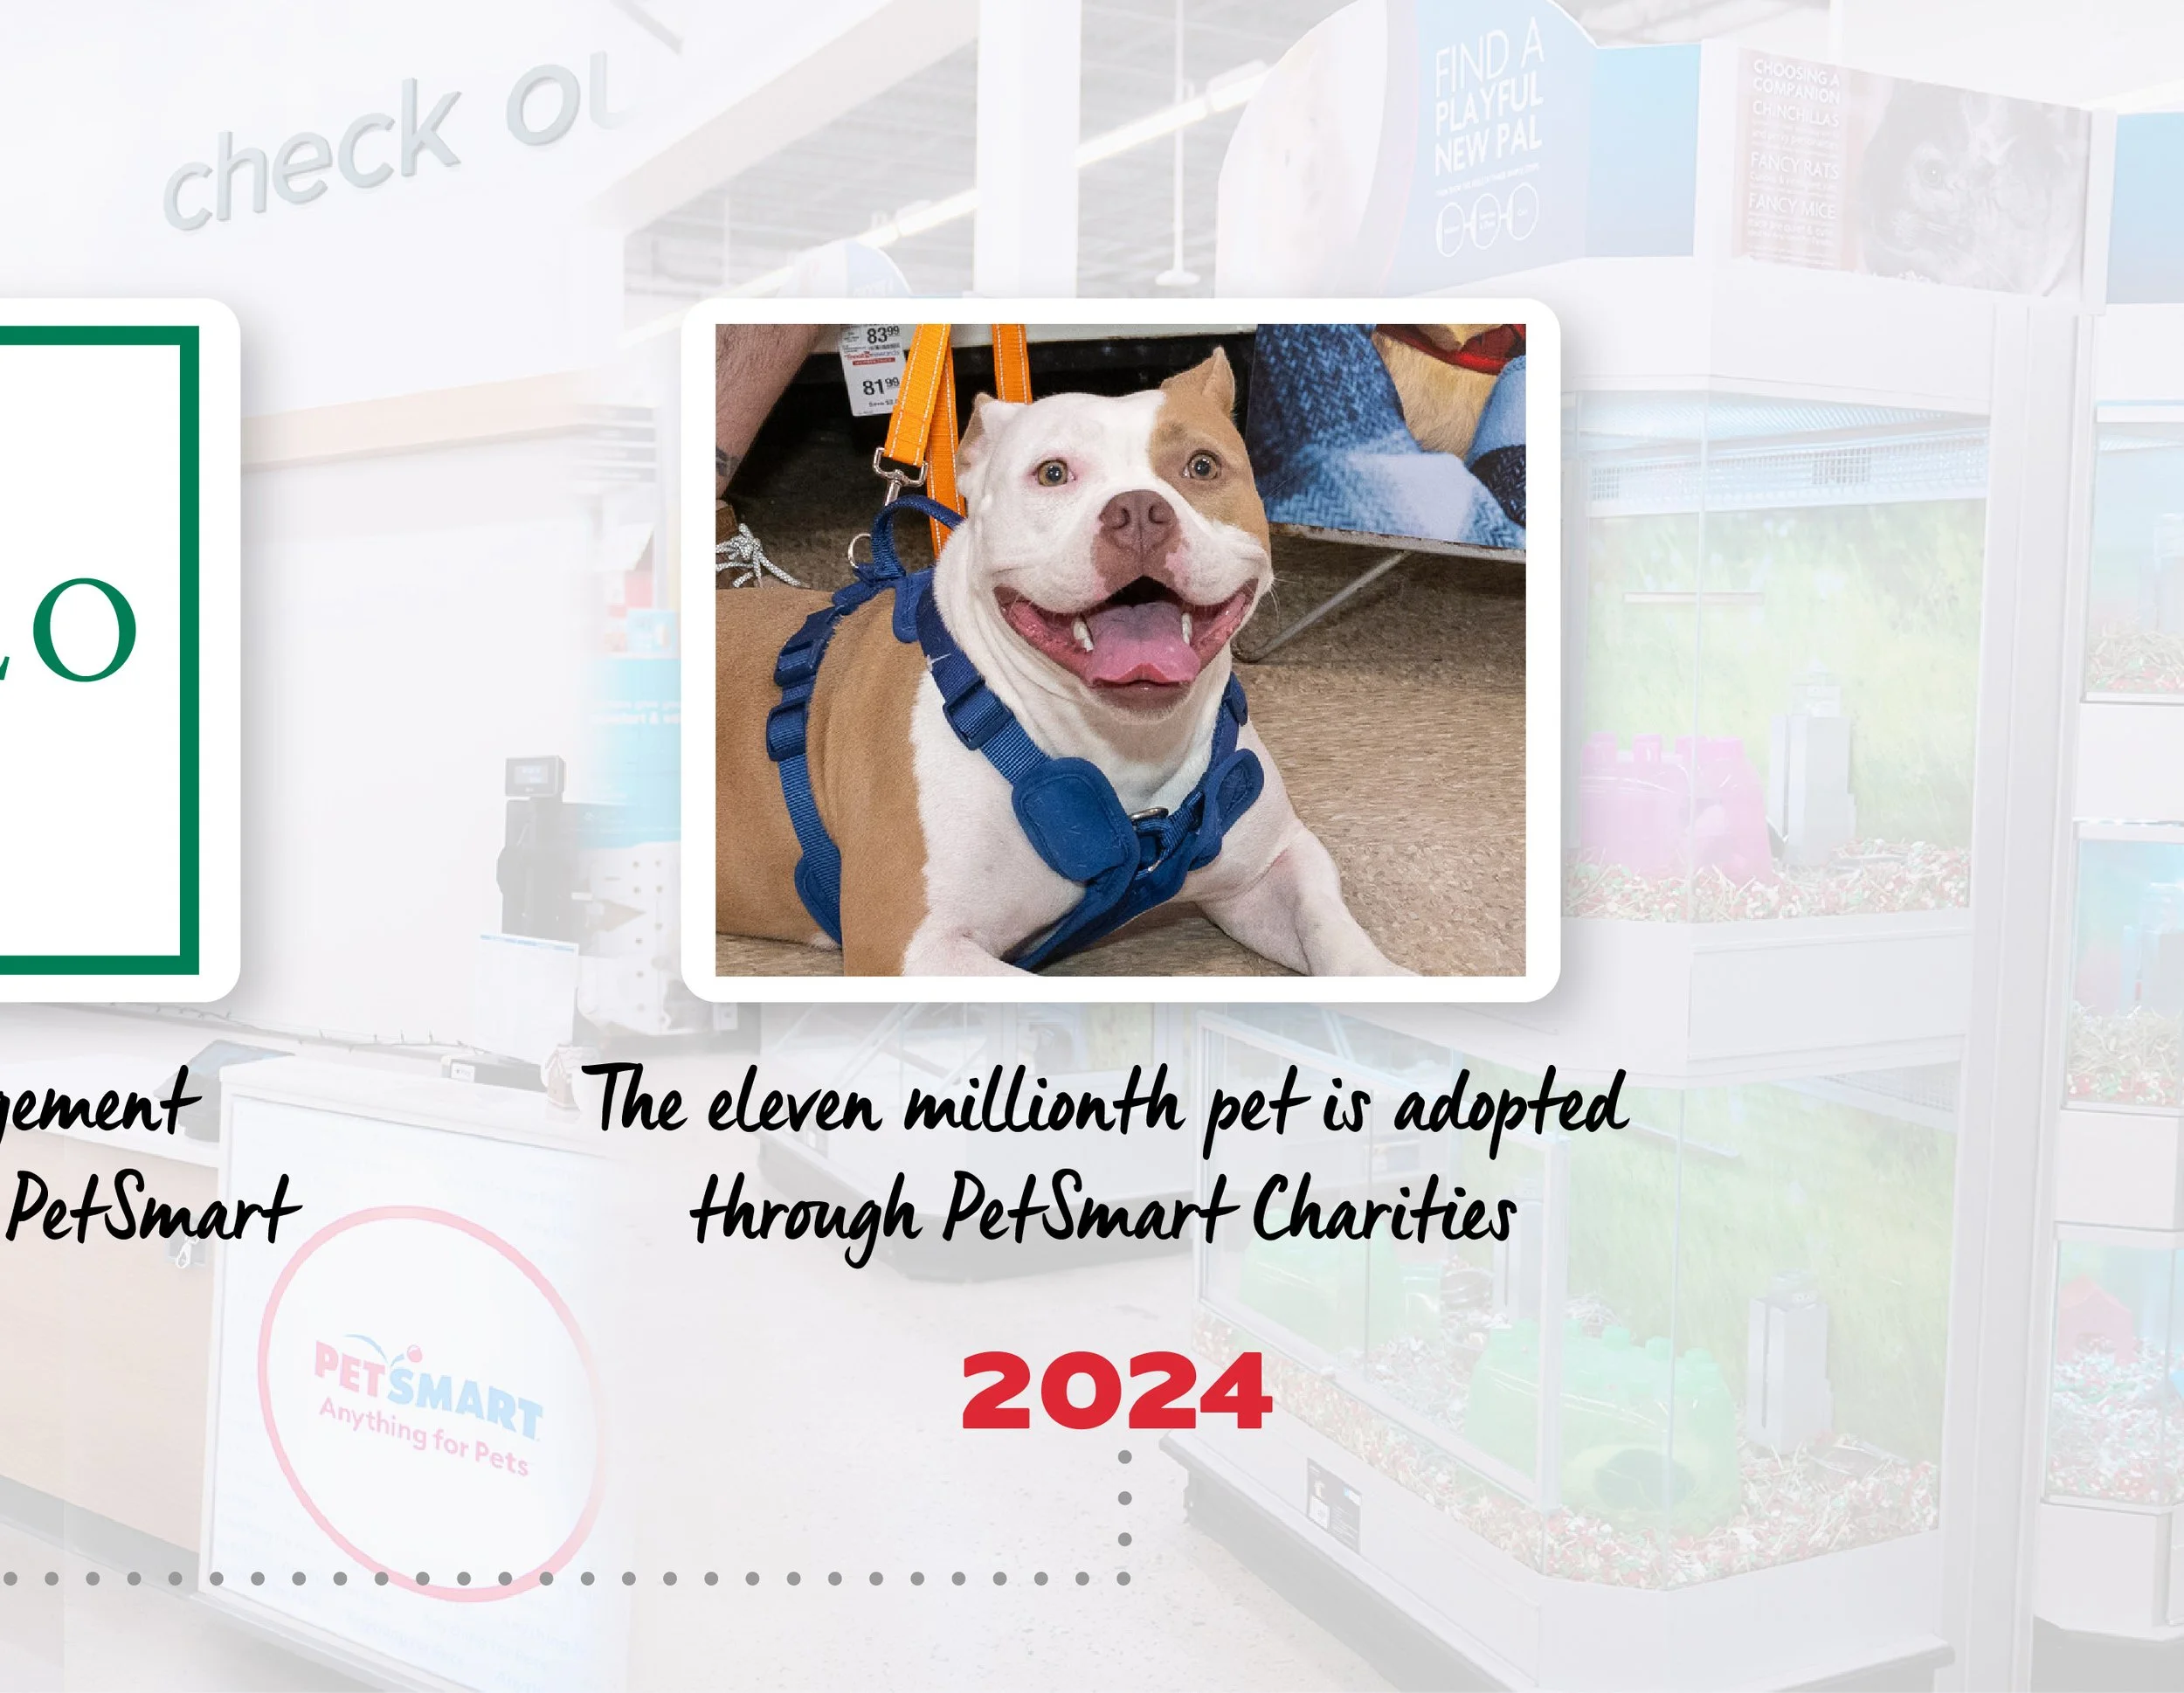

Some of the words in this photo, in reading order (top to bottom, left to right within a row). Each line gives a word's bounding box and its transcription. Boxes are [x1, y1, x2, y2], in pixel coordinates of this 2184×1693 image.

[1435, 29, 1510, 98] FIND
[1520, 16, 1545, 69] A
[1753, 58, 1828, 86] CHOOSING
[1829, 73, 1841, 88] A
[1435, 69, 1545, 137] PLAYFUL
[1752, 77, 1841, 105] COMPANION
[1752, 99, 1841, 128] CHINCHILLAS
[162, 76, 463, 232] check
[1434, 128, 1490, 177] NEW
[1496, 114, 1543, 160] PAL
[1750, 151, 1800, 174] FANCY
[1802, 159, 1841, 181] RATS
[1748, 191, 1798, 215] FANCY
[1800, 201, 1838, 220] MICE
[314, 1338, 543, 1441] PETSMART
[319, 1397, 427, 1451] Anything
[432, 1428, 469, 1457] for
[474, 1440, 529, 1477] Pets
